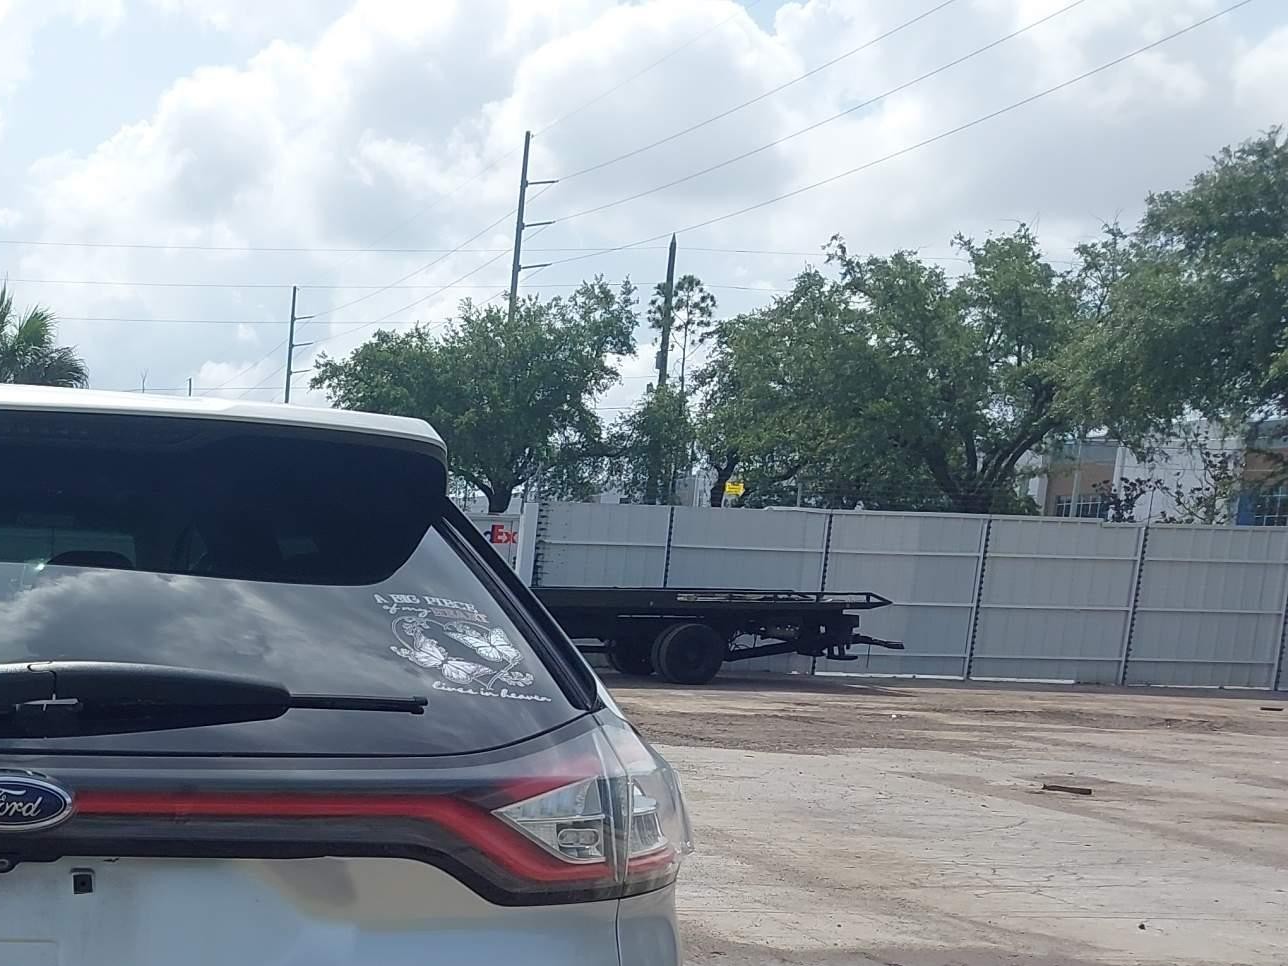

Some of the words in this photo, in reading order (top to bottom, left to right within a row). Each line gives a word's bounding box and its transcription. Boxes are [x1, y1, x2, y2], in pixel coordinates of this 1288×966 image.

[373, 593, 389, 604] A
[389, 594, 420, 604] BIG
[423, 596, 475, 611] PIECE
[382, 603, 401, 614] of
[402, 605, 431, 618] my
[480, 687, 499, 697] in
[500, 688, 551, 702] heaven
